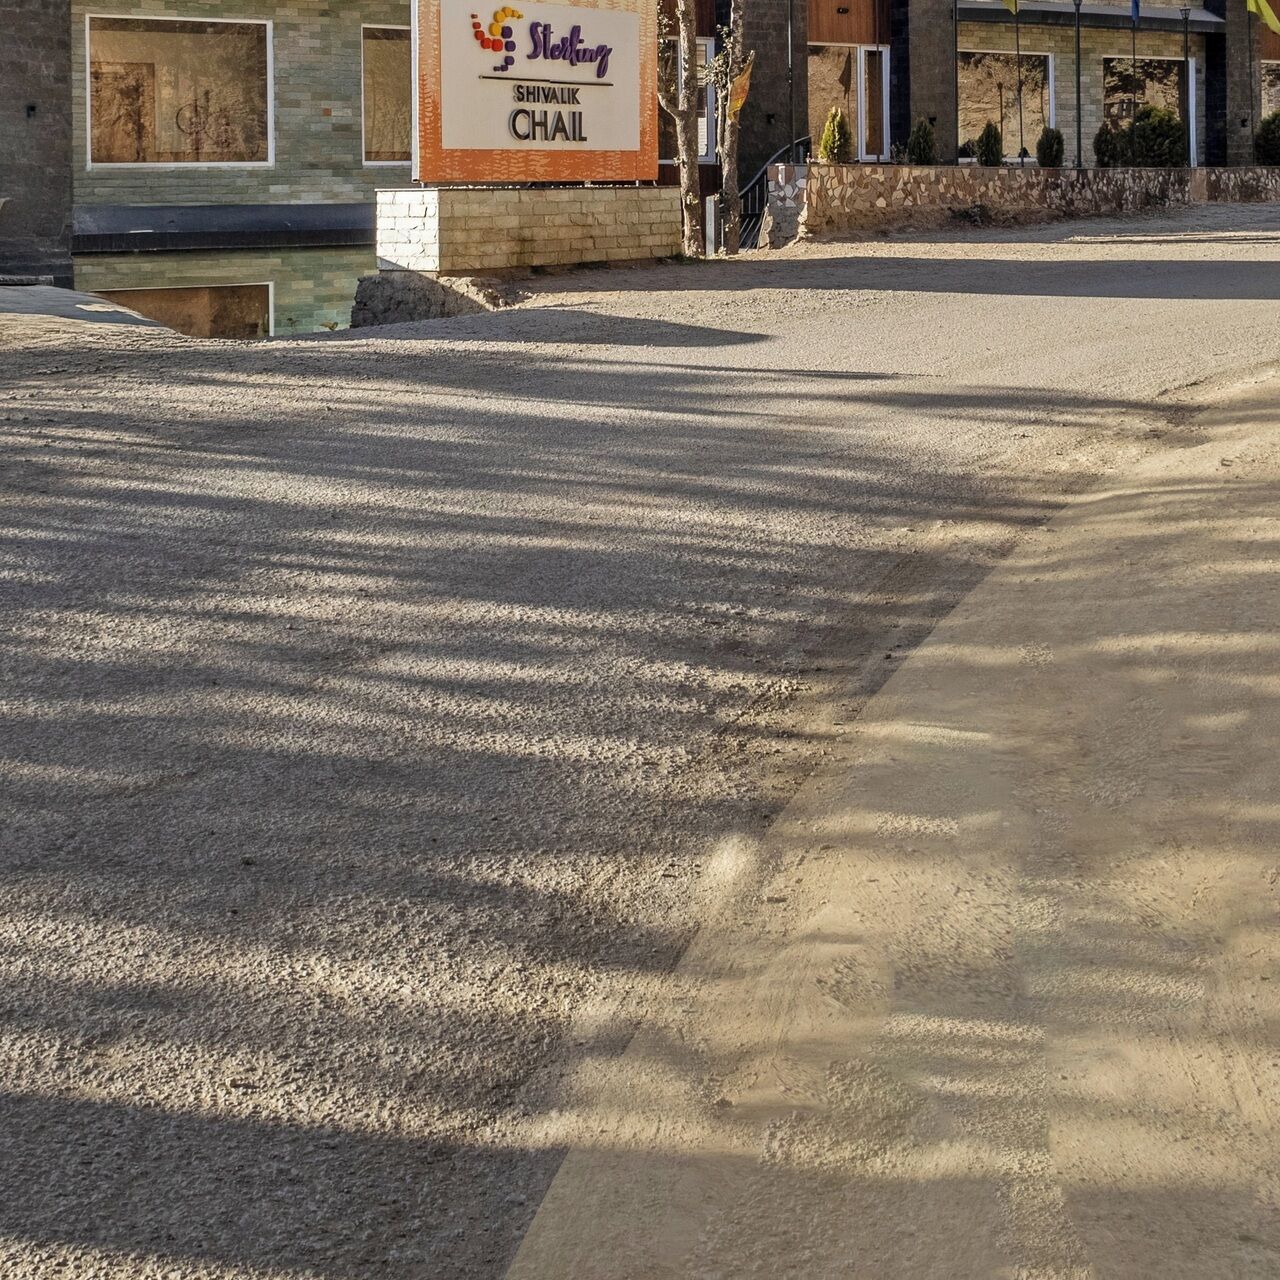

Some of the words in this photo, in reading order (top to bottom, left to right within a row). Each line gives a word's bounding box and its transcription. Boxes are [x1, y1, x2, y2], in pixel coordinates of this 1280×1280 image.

[526, 21, 613, 78] Sterling
[513, 84, 581, 105] SHIVALIK
[509, 108, 588, 142] CHAIL
